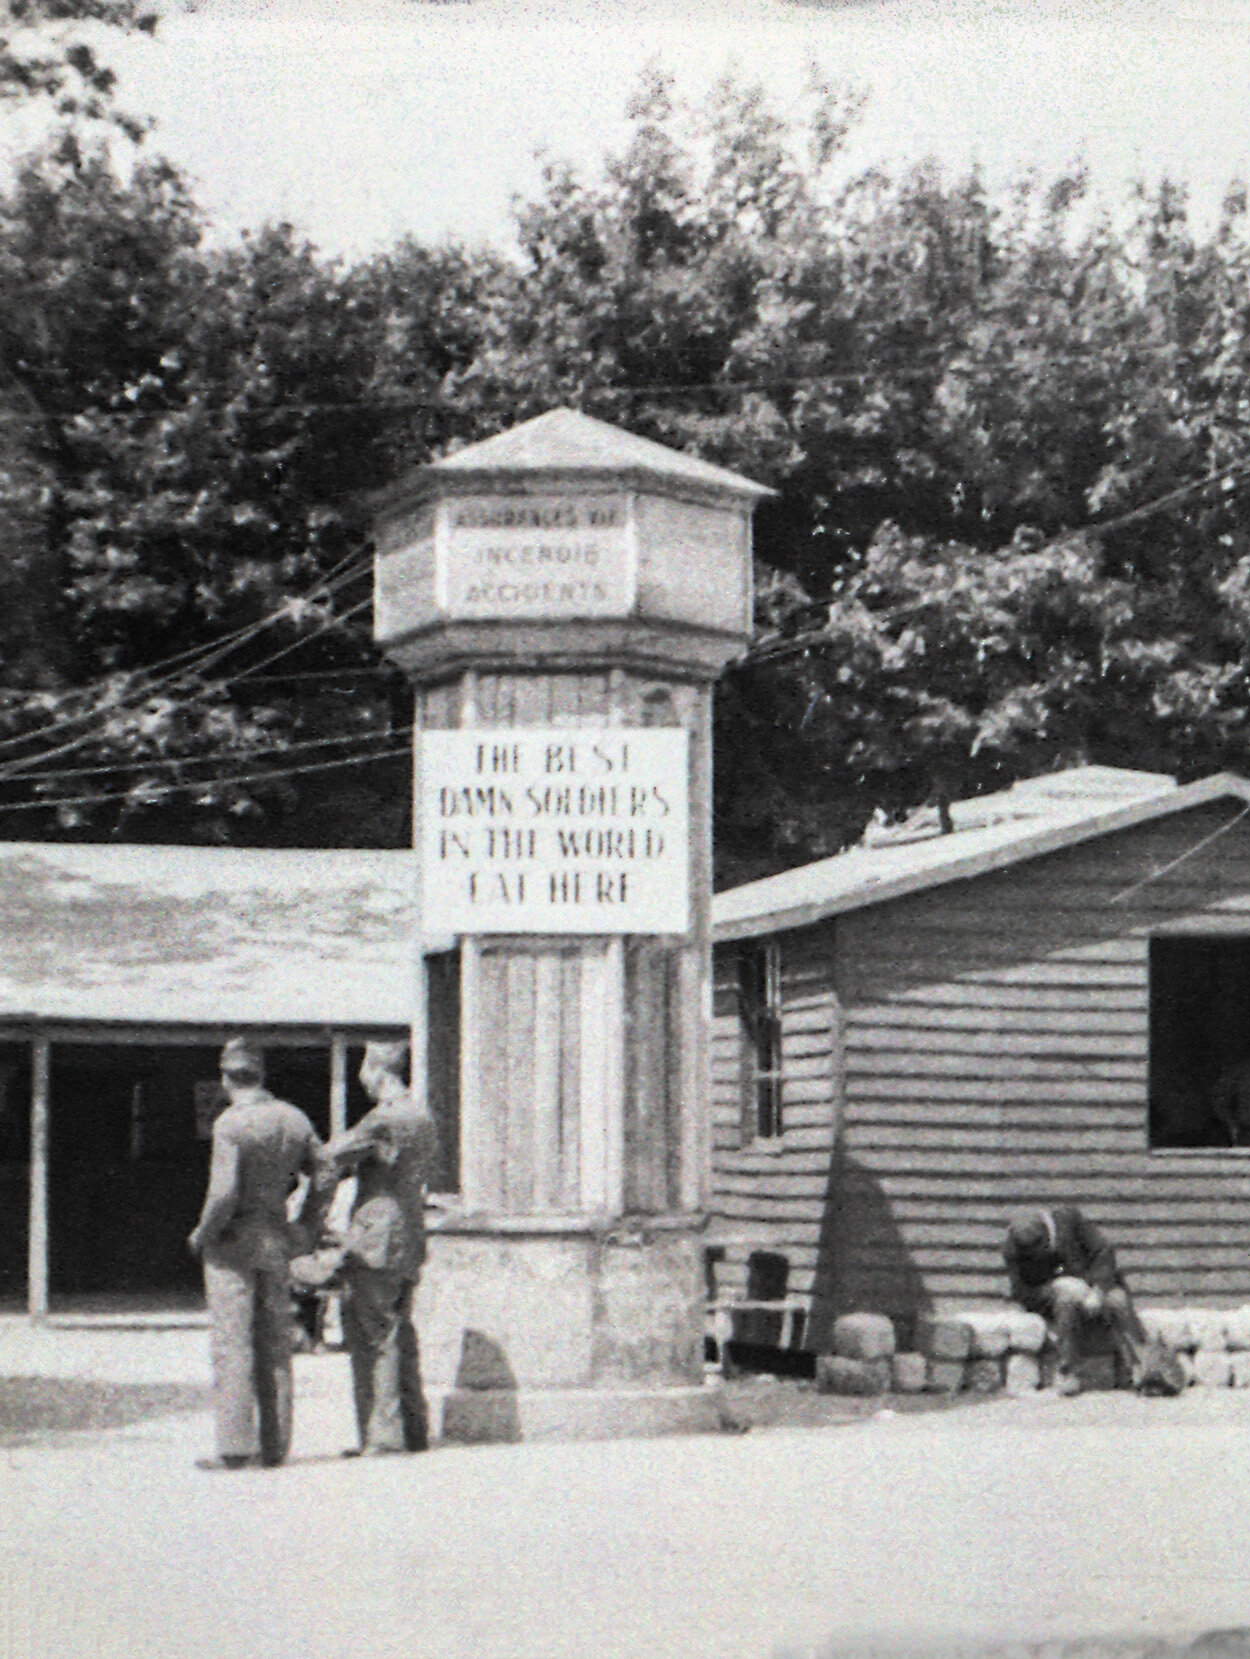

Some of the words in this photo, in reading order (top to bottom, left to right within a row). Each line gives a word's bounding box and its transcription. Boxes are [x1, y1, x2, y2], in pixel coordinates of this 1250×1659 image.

[475, 544, 599, 565] INCENDIE
[466, 581, 606, 602] ACCIDENTS
[477, 743, 520, 774] THE
[546, 743, 629, 773] BEST
[440, 785, 512, 817] DAMN
[526, 785, 669, 817] SOLDIERS
[440, 828, 469, 860] IN
[487, 828, 536, 859] THE
[558, 828, 665, 858] WORLD
[469, 872, 525, 903] EAT
[550, 872, 628, 903] HERE
